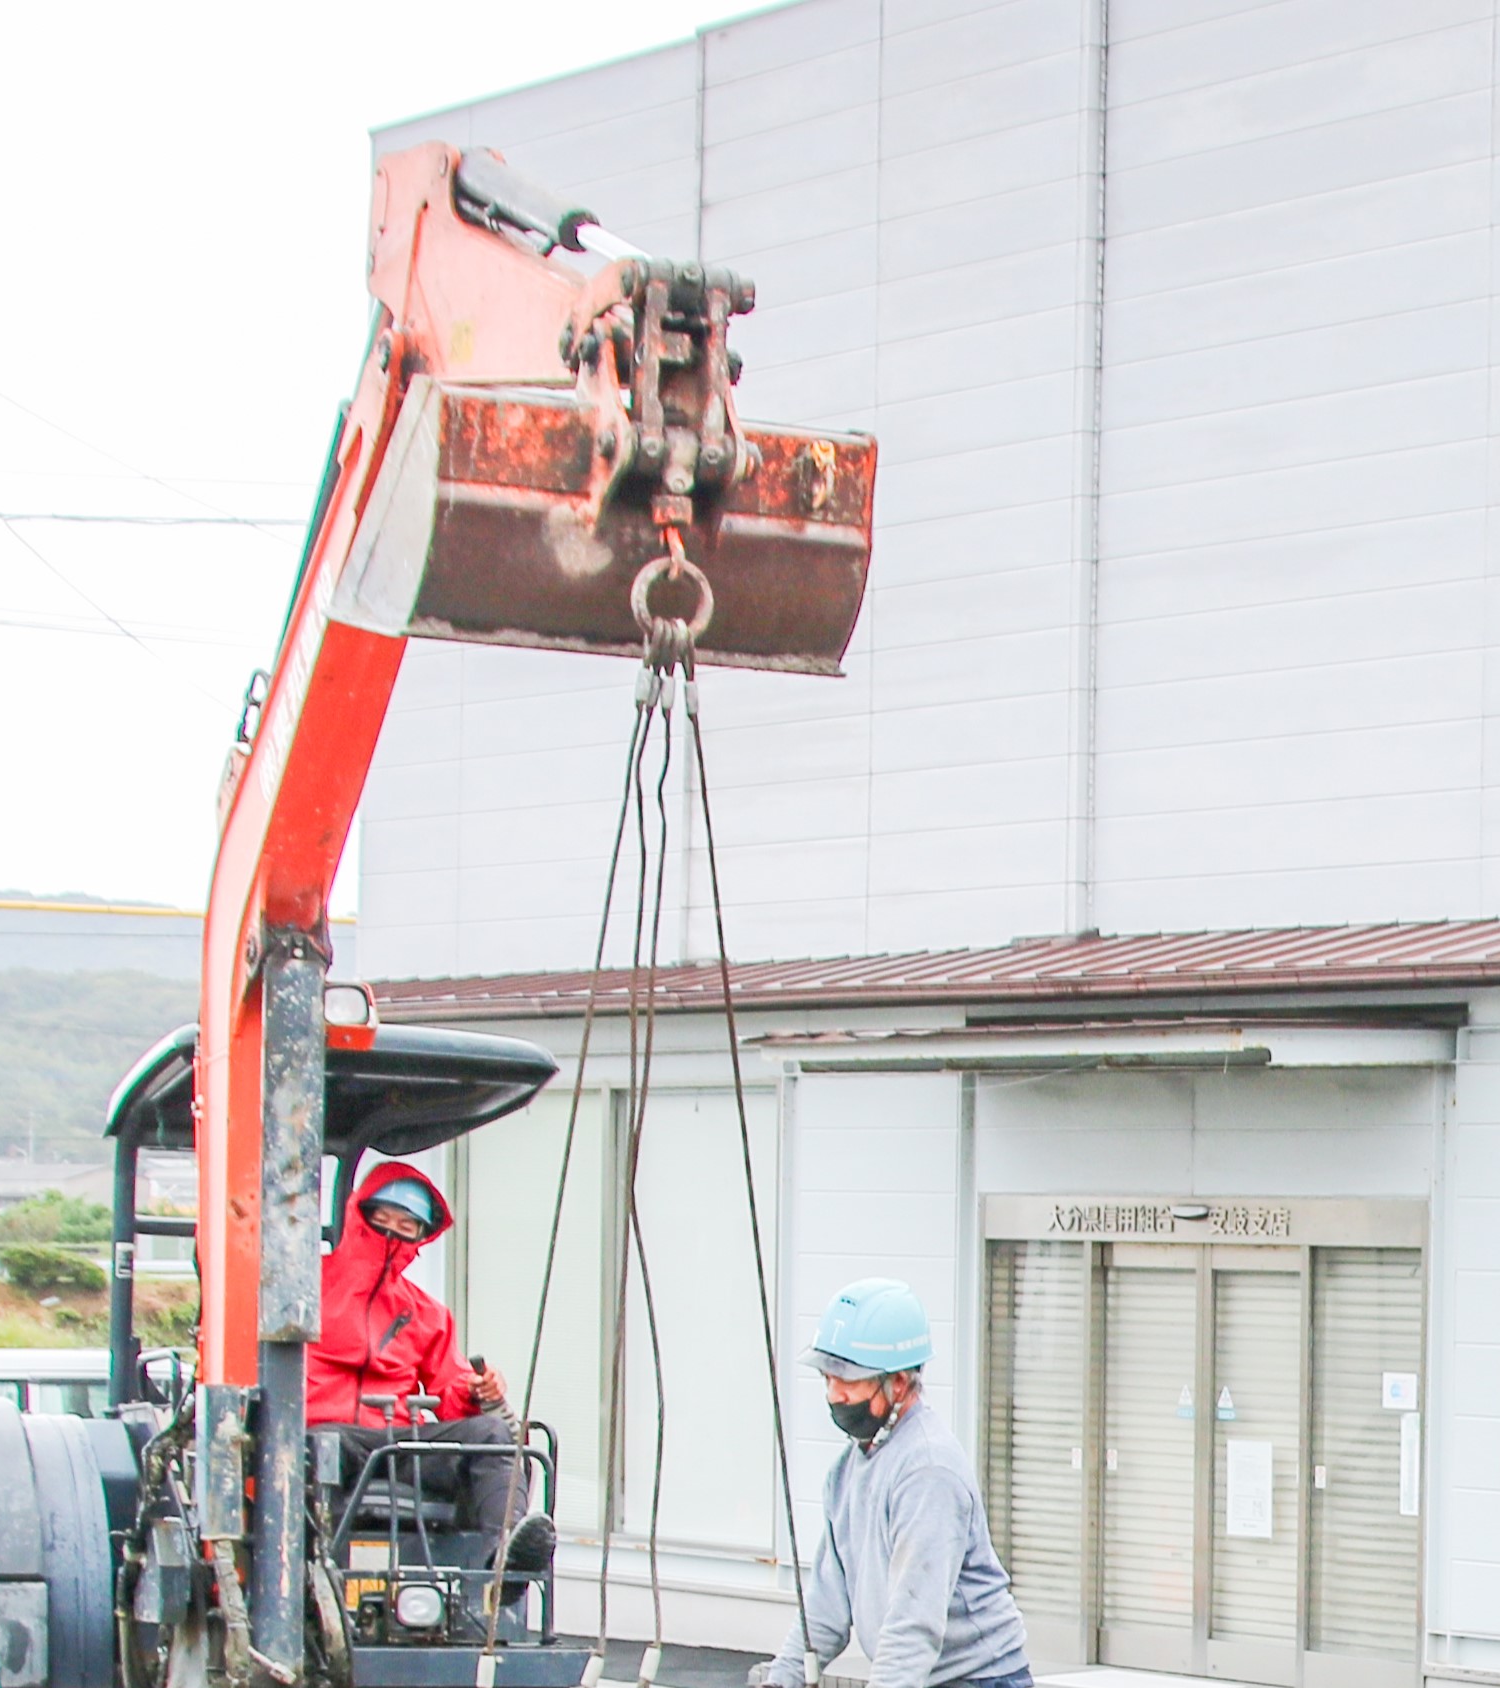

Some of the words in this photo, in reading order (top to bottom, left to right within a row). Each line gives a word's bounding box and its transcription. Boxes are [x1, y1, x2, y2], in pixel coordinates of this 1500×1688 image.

[1049, 1204, 1175, 1233] 大分県信用組合
[1207, 1206, 1292, 1236] 安岐支店
